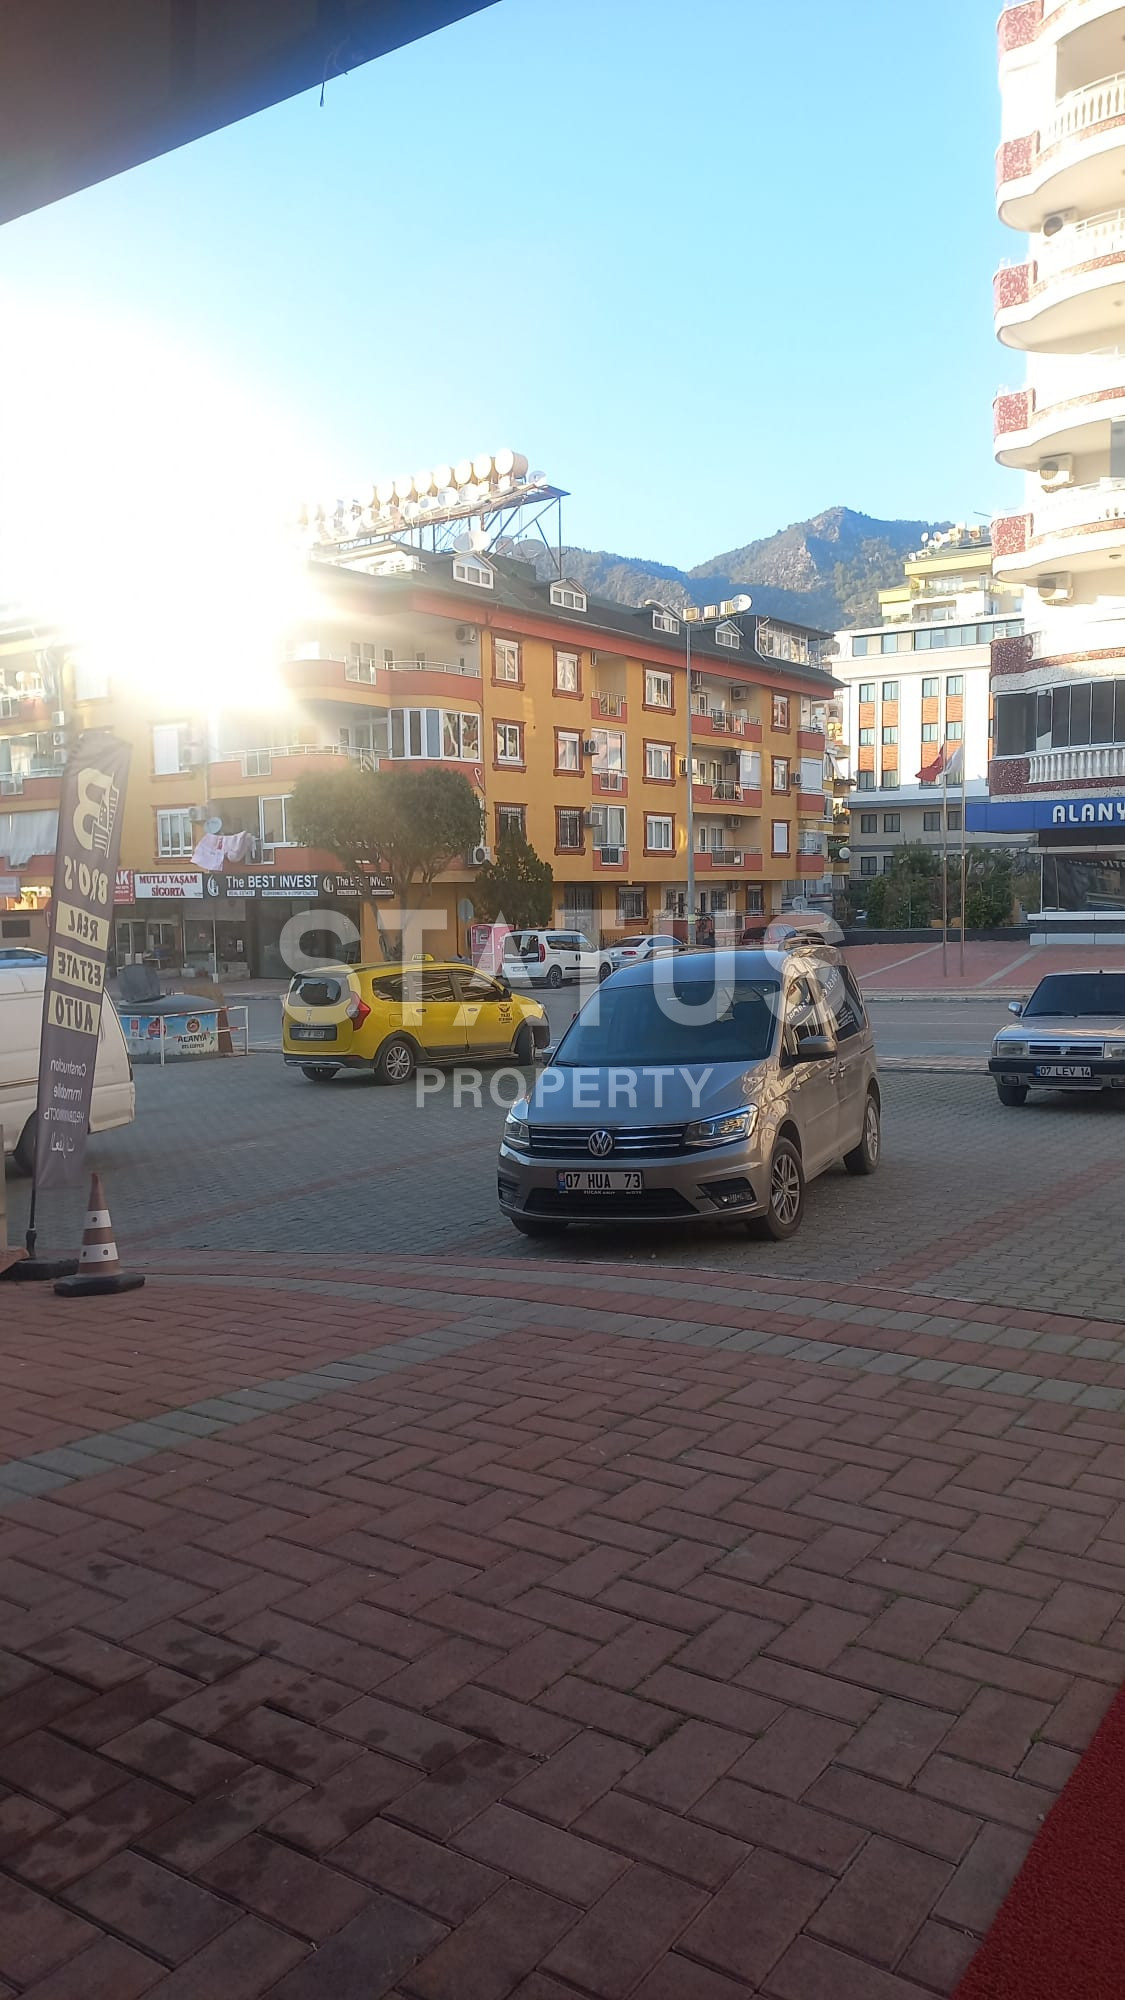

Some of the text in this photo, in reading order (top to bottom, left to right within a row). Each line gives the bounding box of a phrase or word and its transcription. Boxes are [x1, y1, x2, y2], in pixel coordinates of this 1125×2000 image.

[1052, 802, 1125, 823] ALANY
[139, 875, 198, 885] MUTLU YAŞAM
[226, 875, 319, 888] The BEST INVEST
[151, 886, 186, 897] SİGORTA
[1040, 1066, 1090, 1076] 07 LEV 14
[565, 1173, 641, 1189] 07 HUA 73
